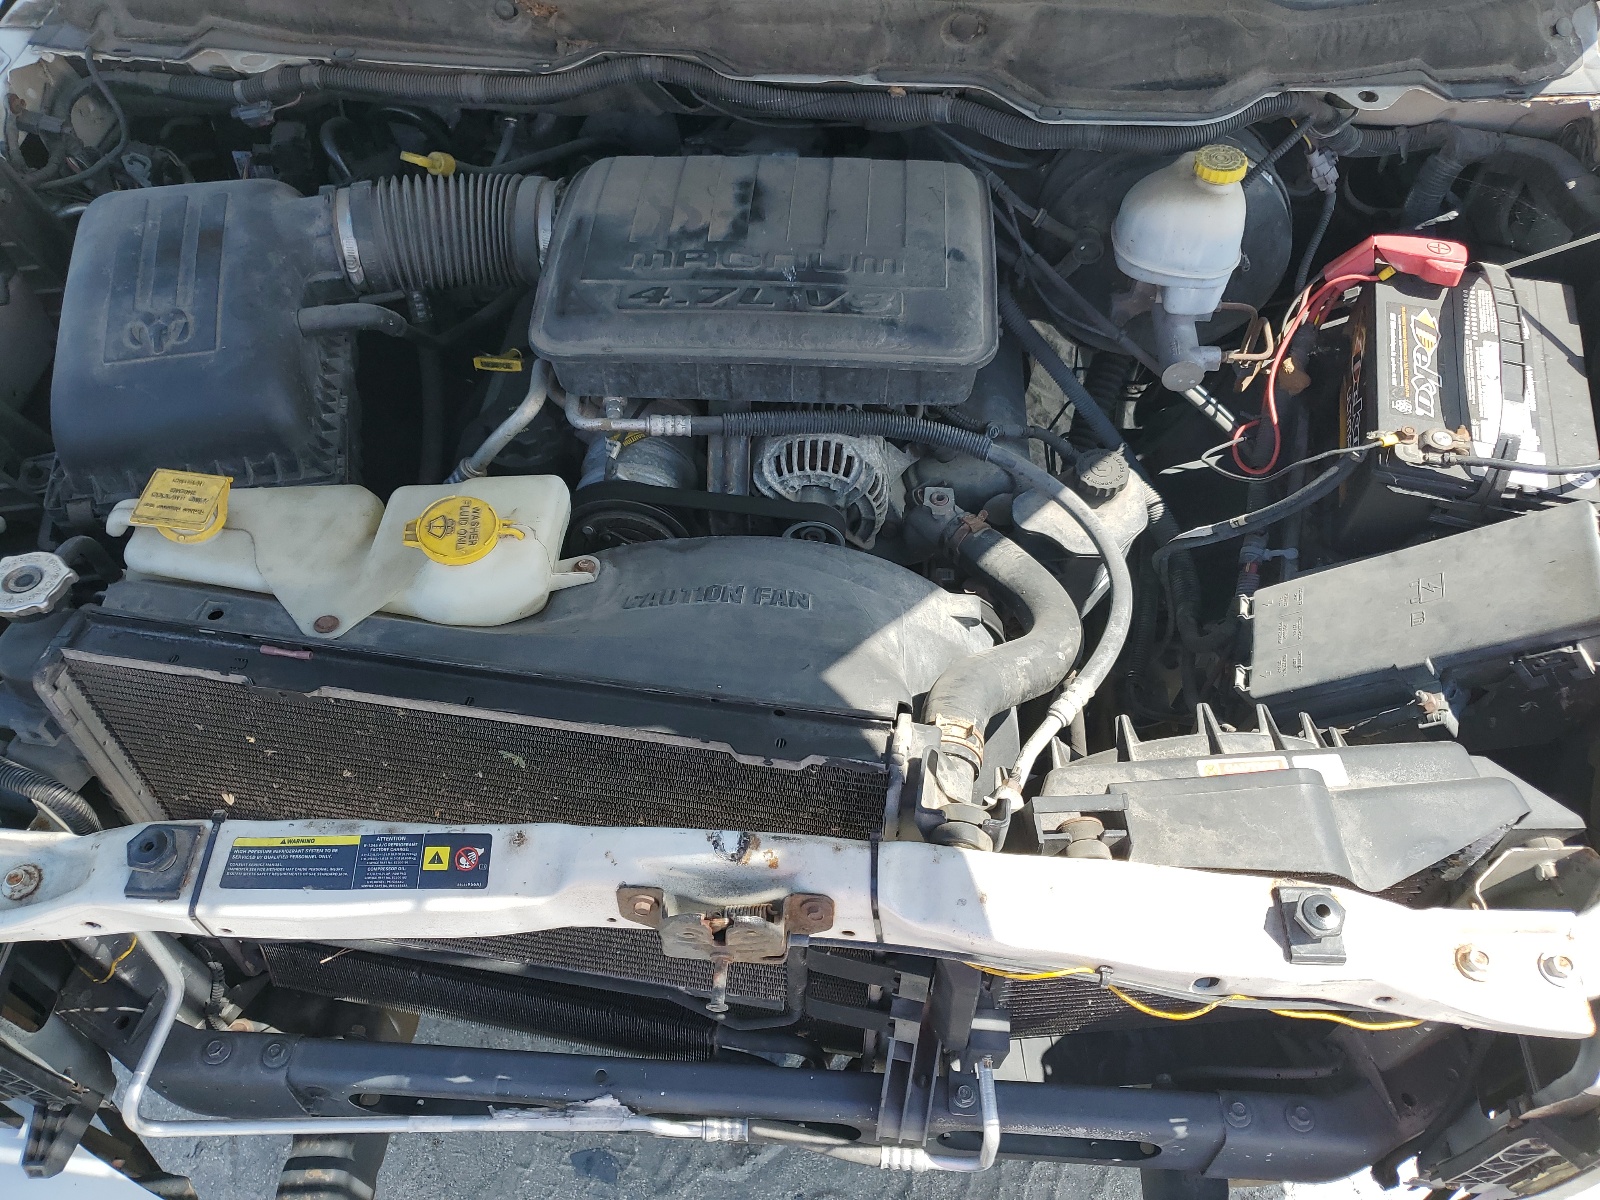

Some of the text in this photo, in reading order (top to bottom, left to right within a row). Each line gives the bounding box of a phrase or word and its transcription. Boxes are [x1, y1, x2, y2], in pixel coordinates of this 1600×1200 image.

[1411, 308, 1443, 418] Deka
[455, 500, 472, 554] FLUID ONLY
[467, 506, 481, 546] WASHER
[622, 584, 812, 610] CAUTION FAN
